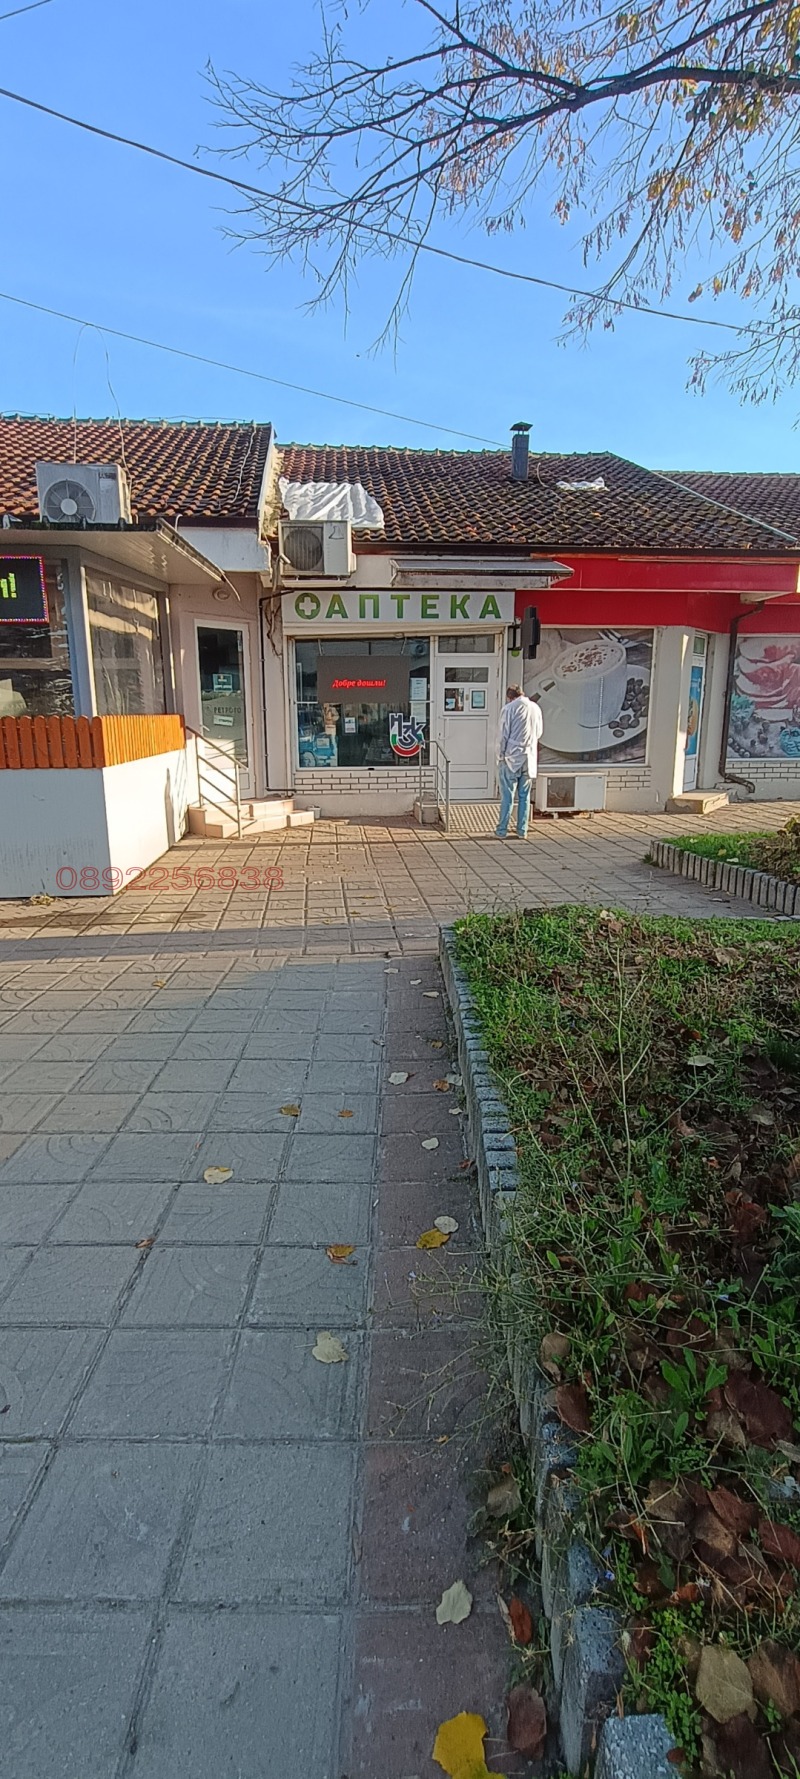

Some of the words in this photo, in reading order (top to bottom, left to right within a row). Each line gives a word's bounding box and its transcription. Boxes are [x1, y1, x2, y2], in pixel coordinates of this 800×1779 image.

[325, 593, 502, 619] АПТЕКА
[332, 679, 356, 689] Добре
[357, 679, 386, 688] дошли!
